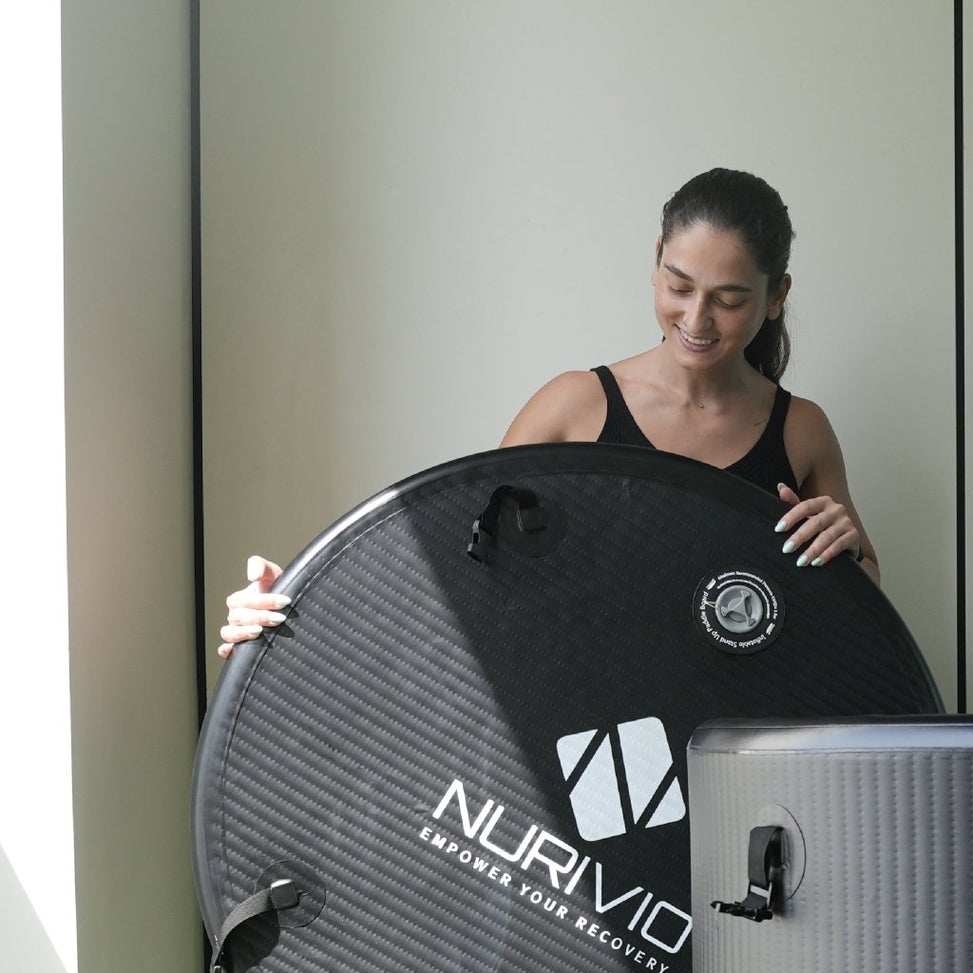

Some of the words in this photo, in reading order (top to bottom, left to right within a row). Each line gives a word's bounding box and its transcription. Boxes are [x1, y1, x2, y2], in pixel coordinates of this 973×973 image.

[700, 611, 713, 632] Paddle
[712, 630, 721, 641] Up
[720, 637, 737, 648] Stand
[738, 634, 766, 648] Inflatable
[419, 826, 512, 887] EMPOWER
[519, 883, 568, 921] YOUR
[432, 778, 693, 954] NURIVIO
